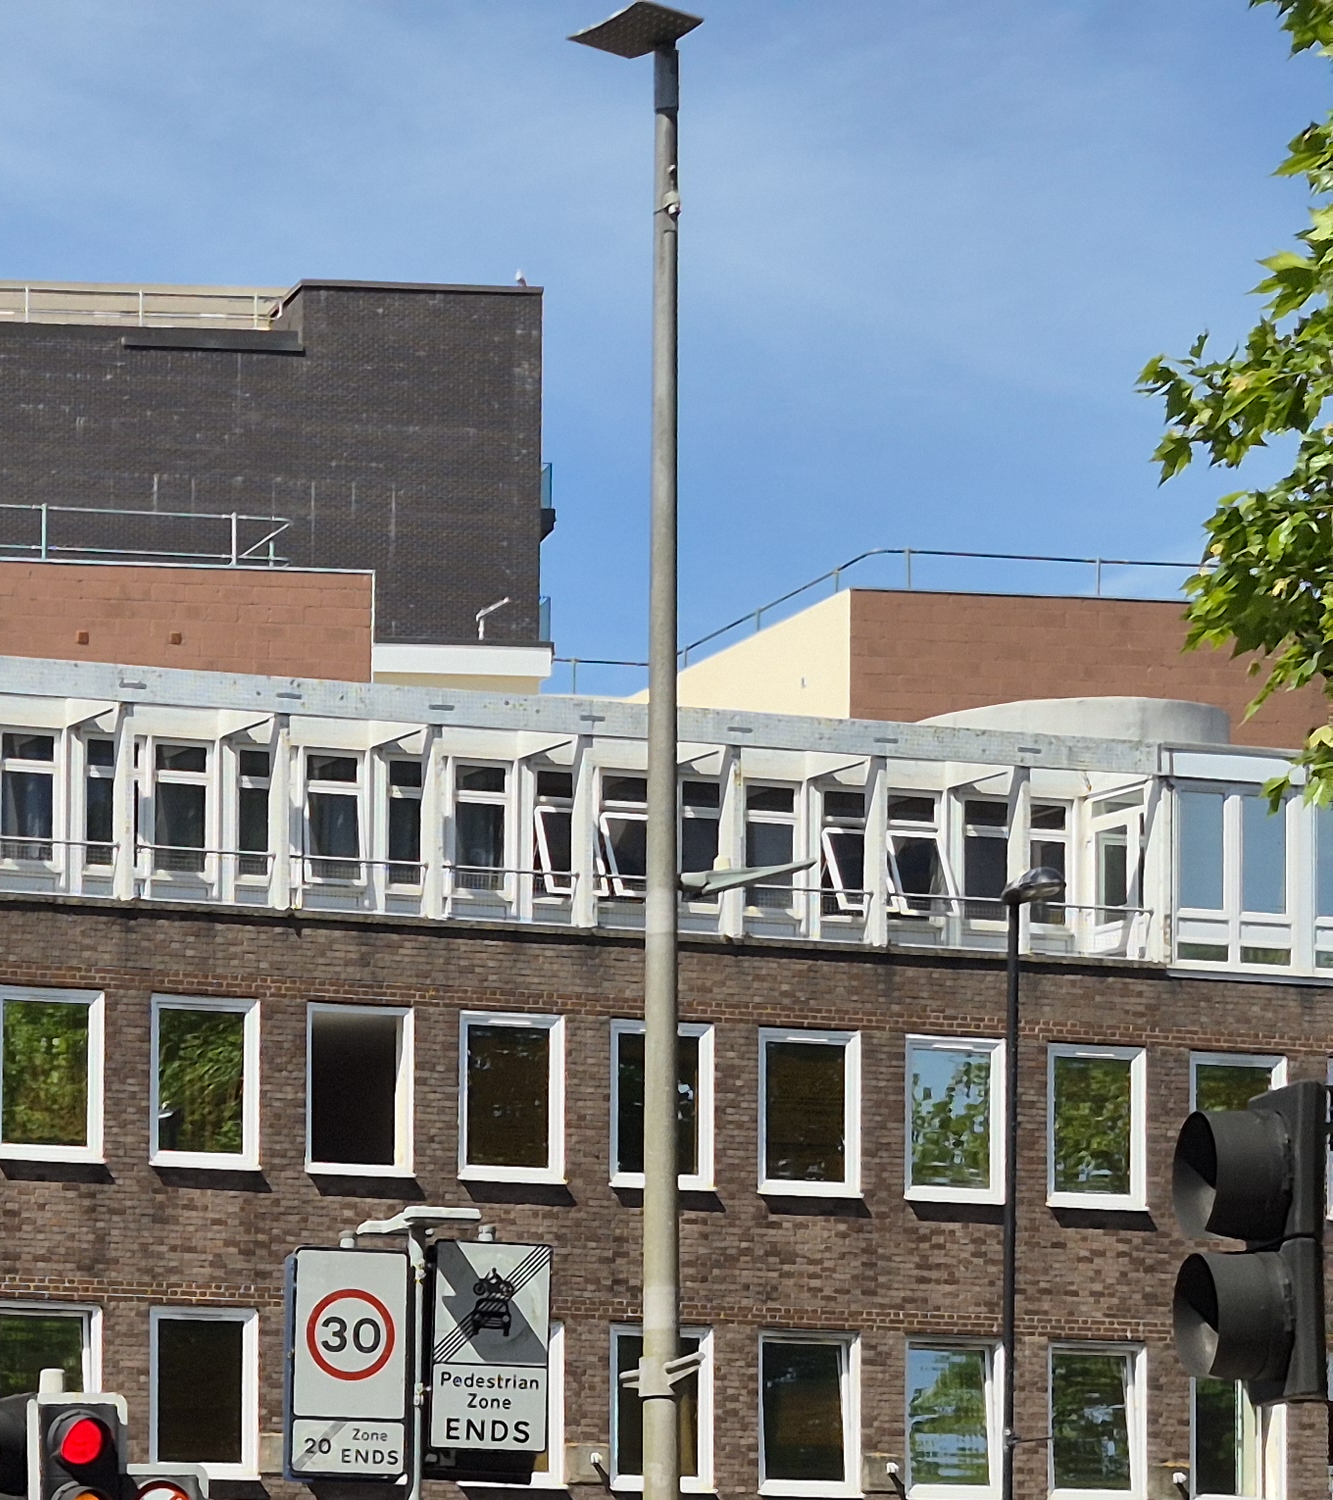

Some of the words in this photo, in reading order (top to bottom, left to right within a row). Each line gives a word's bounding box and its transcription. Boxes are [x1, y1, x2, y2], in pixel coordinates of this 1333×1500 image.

[321, 1316, 381, 1354] 30
[440, 1371, 539, 1390] Pedestrian
[467, 1393, 512, 1410] Zone
[352, 1428, 388, 1442] Zone
[446, 1418, 530, 1444] ENDS
[304, 1437, 332, 1455] 20
[341, 1448, 399, 1466] ENDS
